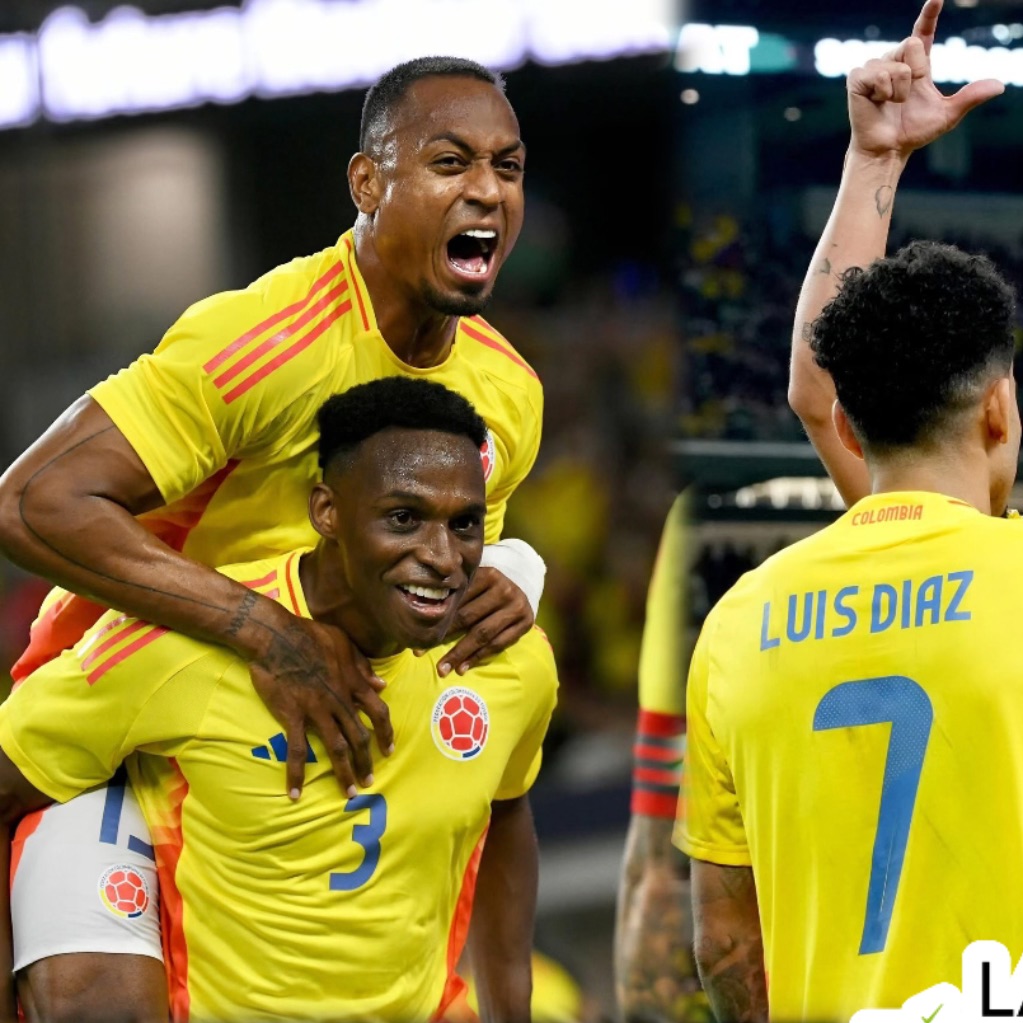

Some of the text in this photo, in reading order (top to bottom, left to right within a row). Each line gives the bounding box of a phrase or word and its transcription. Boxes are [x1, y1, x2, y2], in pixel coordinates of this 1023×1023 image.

[852, 505, 924, 526] COLOMBIA
[760, 570, 974, 652] LUIS DIAZ
[329, 793, 388, 891] 3
[812, 675, 934, 955] 7
